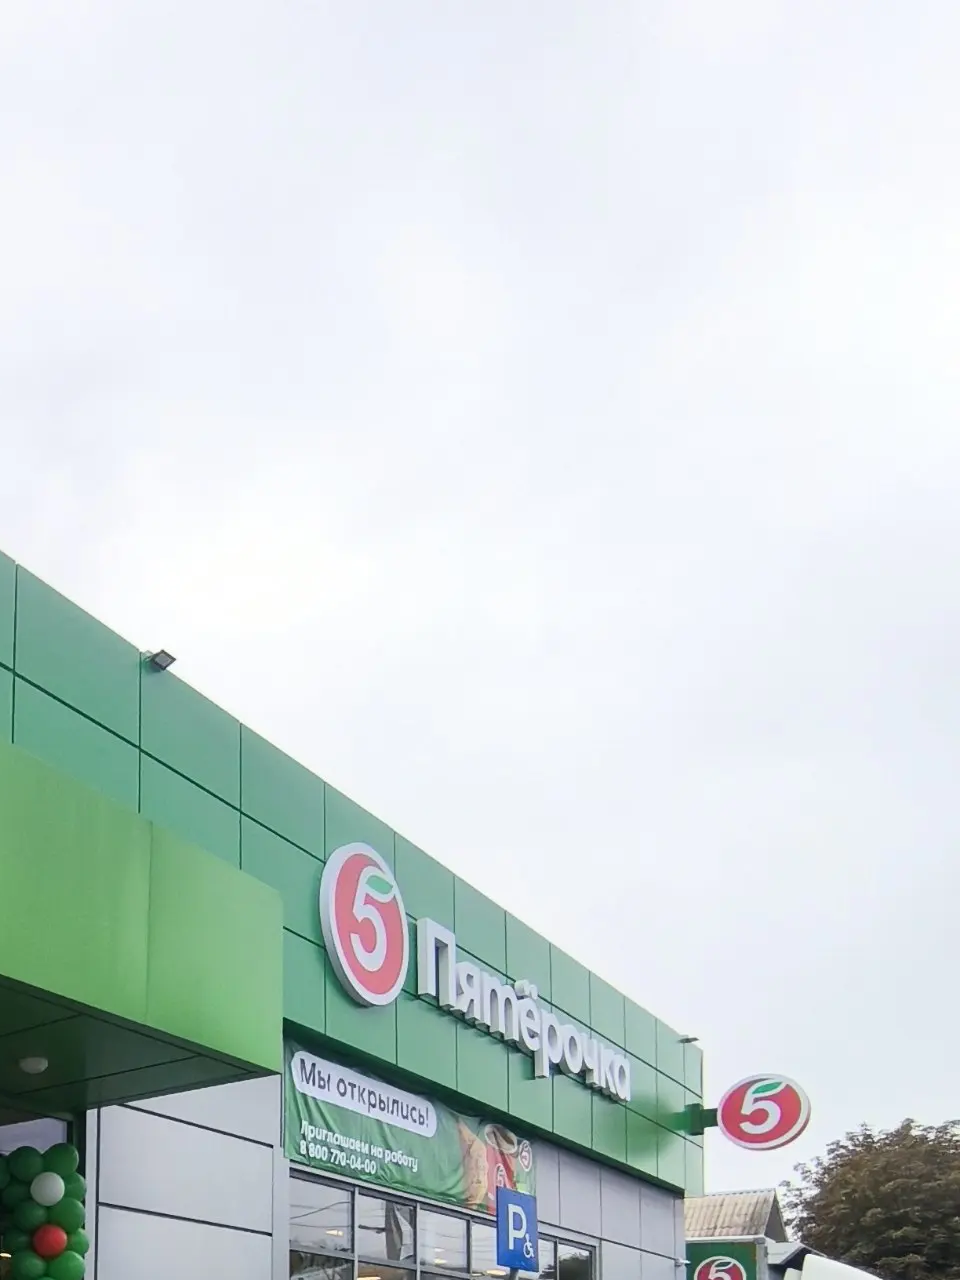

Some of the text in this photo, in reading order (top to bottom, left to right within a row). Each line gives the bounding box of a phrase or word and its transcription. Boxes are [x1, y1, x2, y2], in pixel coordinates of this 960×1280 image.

[416, 917, 632, 1103] Пятёрочка
[300, 1058, 429, 1128] Мы открылись!
[299, 1140, 377, 1174] 8 800 770-04-00
[300, 1120, 418, 1172] Приглашаем на работу
[508, 1203, 527, 1250] P
